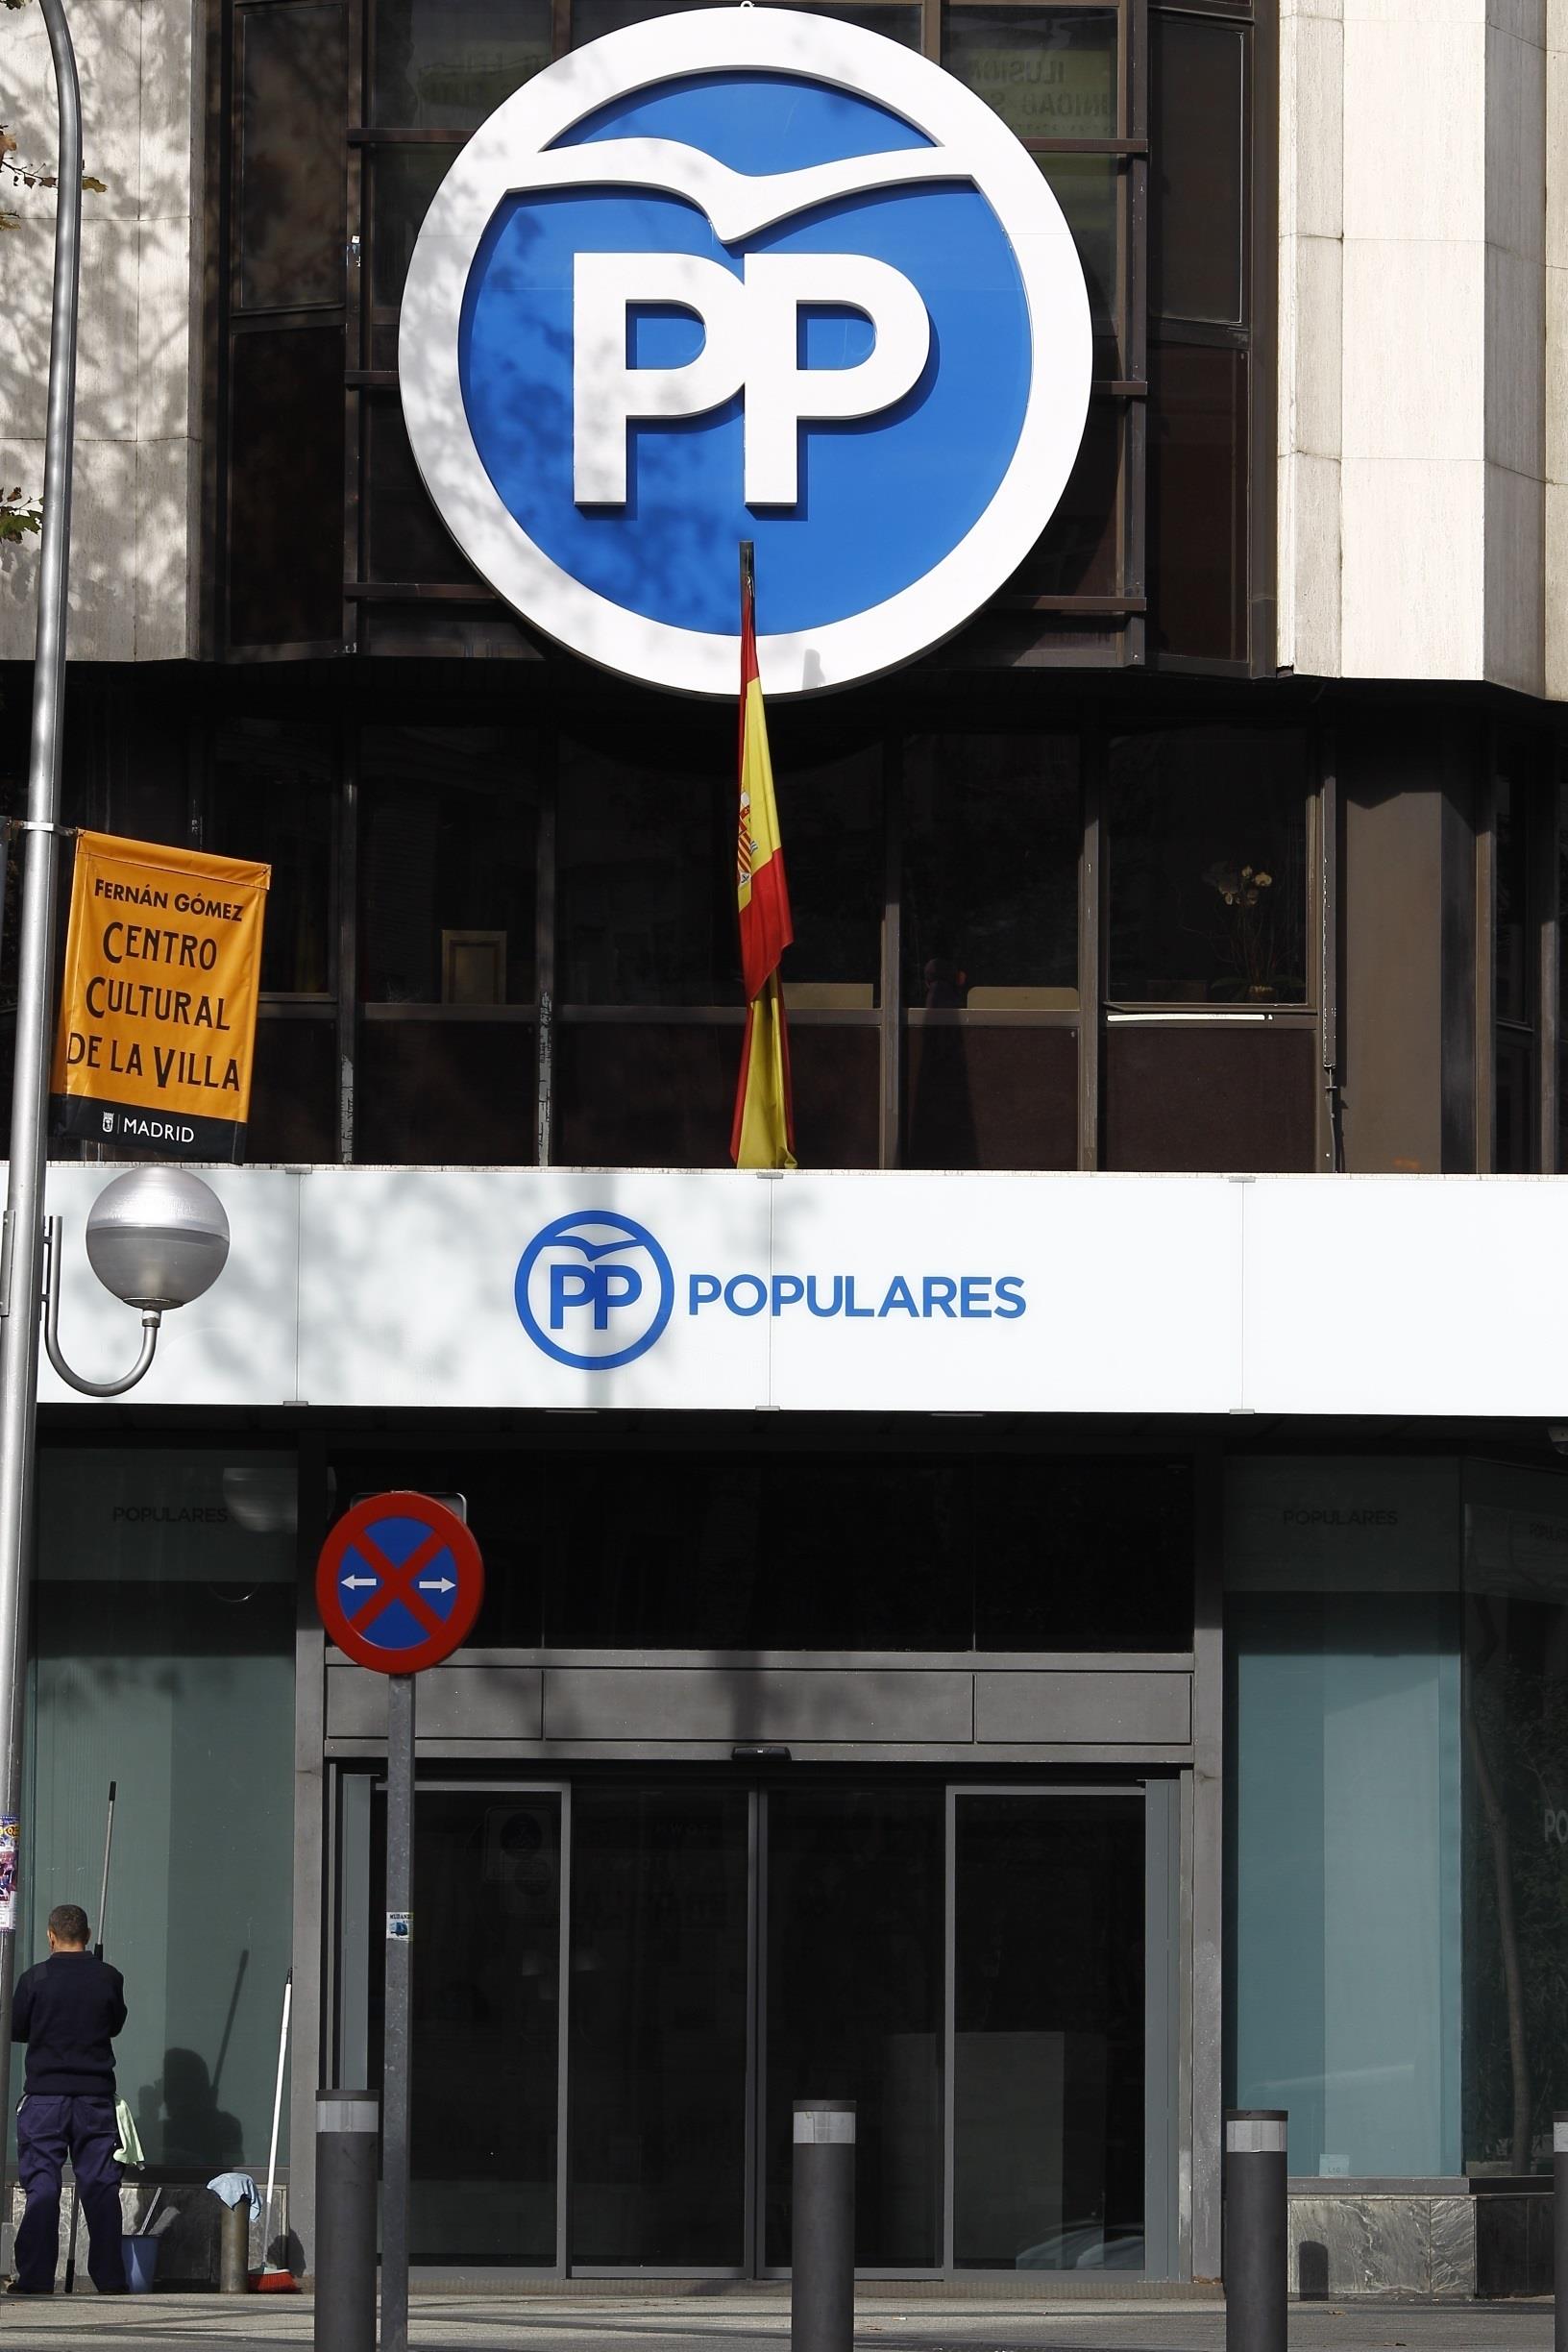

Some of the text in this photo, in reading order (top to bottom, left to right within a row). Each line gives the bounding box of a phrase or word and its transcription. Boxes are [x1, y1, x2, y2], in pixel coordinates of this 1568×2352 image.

[574, 252, 931, 507] PP
[94, 878, 245, 922] FERNÁN GÓMEZ
[103, 921, 217, 970] CENTRO
[86, 976, 231, 1031] CULTURAL
[66, 1032, 241, 1091] DE LA VILLA
[123, 1117, 195, 1143] MADRID
[550, 1263, 1026, 1330] PP POPULARES
[111, 1507, 229, 1523] POPULARES
[1283, 1509, 1398, 1526] POPULARES
